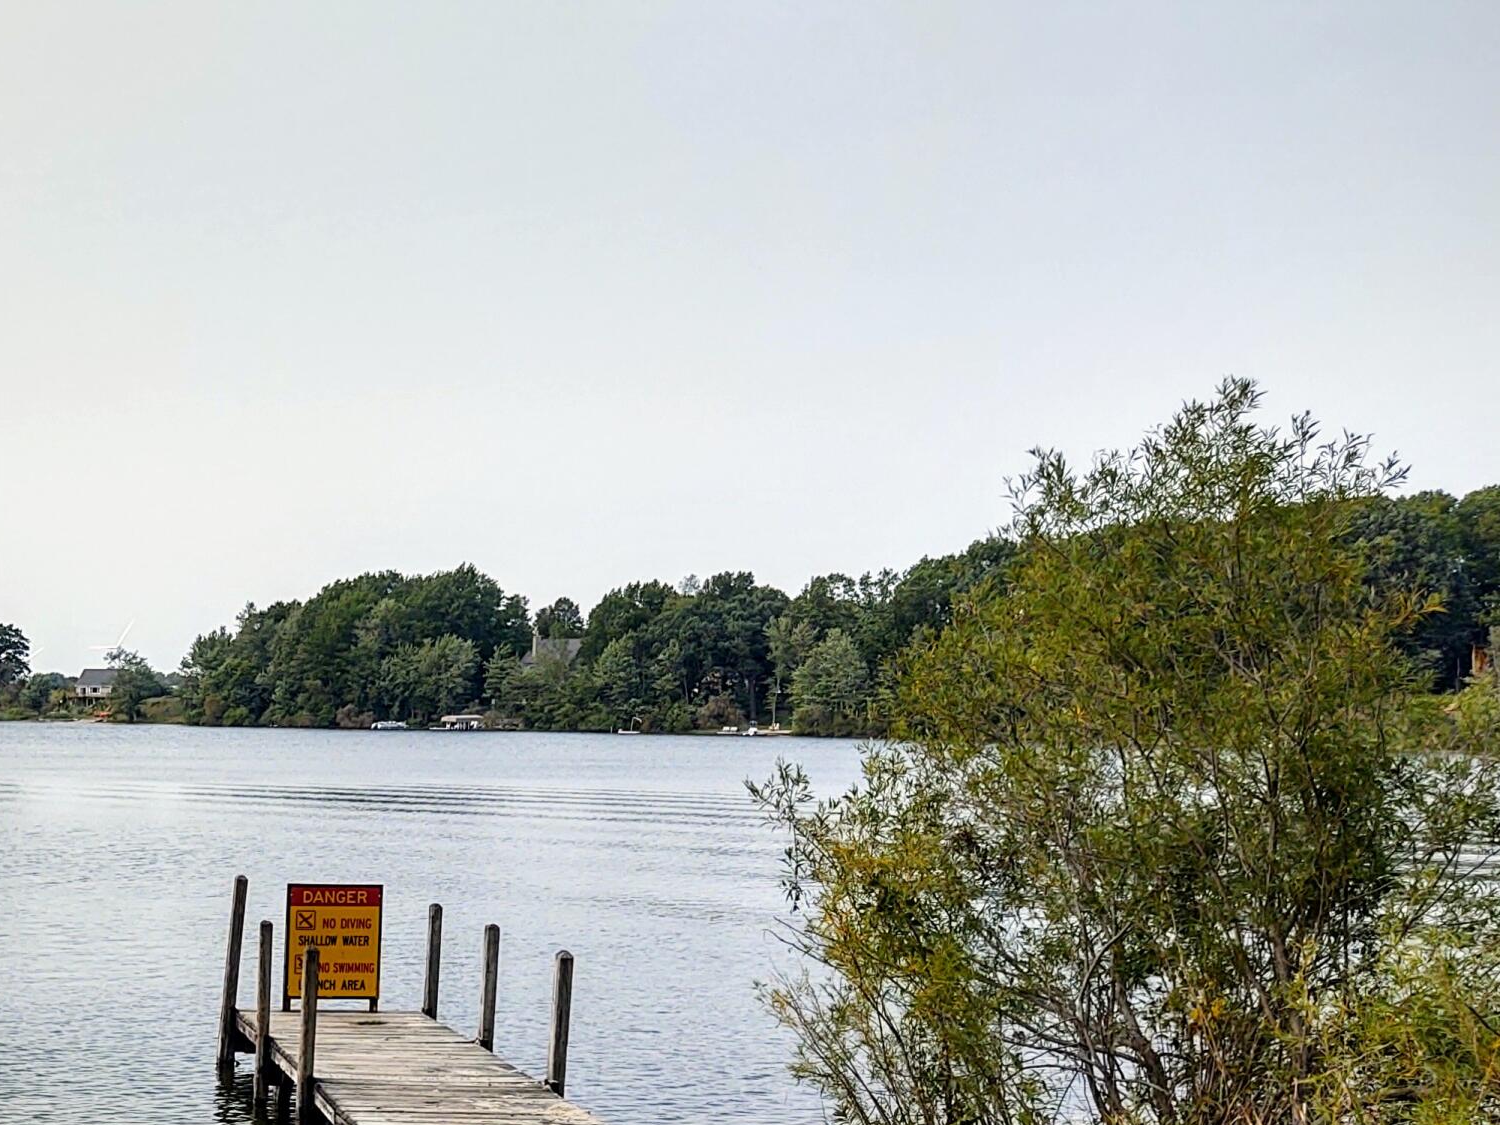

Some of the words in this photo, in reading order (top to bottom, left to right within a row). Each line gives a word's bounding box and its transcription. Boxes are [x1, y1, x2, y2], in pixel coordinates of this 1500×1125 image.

[303, 890, 368, 904] DANGER
[322, 918, 336, 929] NO
[341, 918, 372, 929] DIVING
[298, 935, 338, 947] SHALLOW
[342, 935, 370, 947] WATER
[318, 962, 330, 973] NO
[333, 963, 375, 974] SWIMMING
[341, 980, 366, 991] AREA
